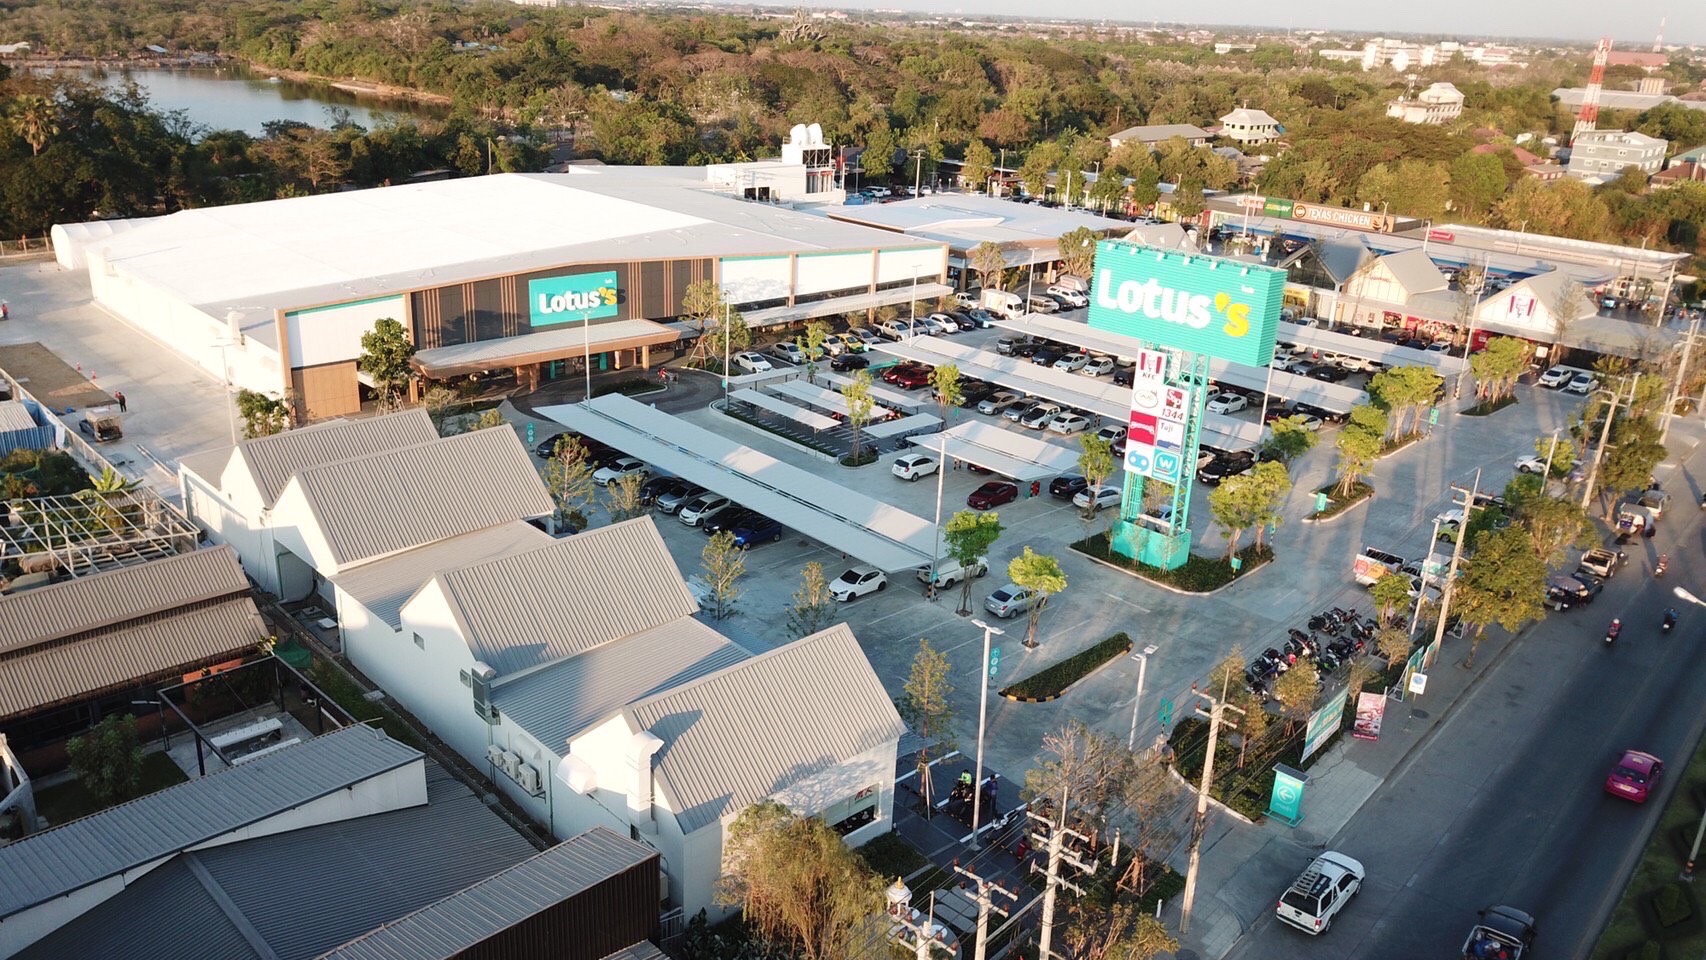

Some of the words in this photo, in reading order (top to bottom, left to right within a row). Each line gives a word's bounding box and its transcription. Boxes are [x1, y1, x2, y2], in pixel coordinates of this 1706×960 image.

[1308, 208, 1332, 220] TEXAS
[1333, 211, 1371, 226] CHICKEN
[538, 286, 618, 314] Lotus's
[1098, 268, 1251, 337] Lotus's
[1142, 372, 1156, 380] KFC
[1161, 408, 1184, 420] 1344
